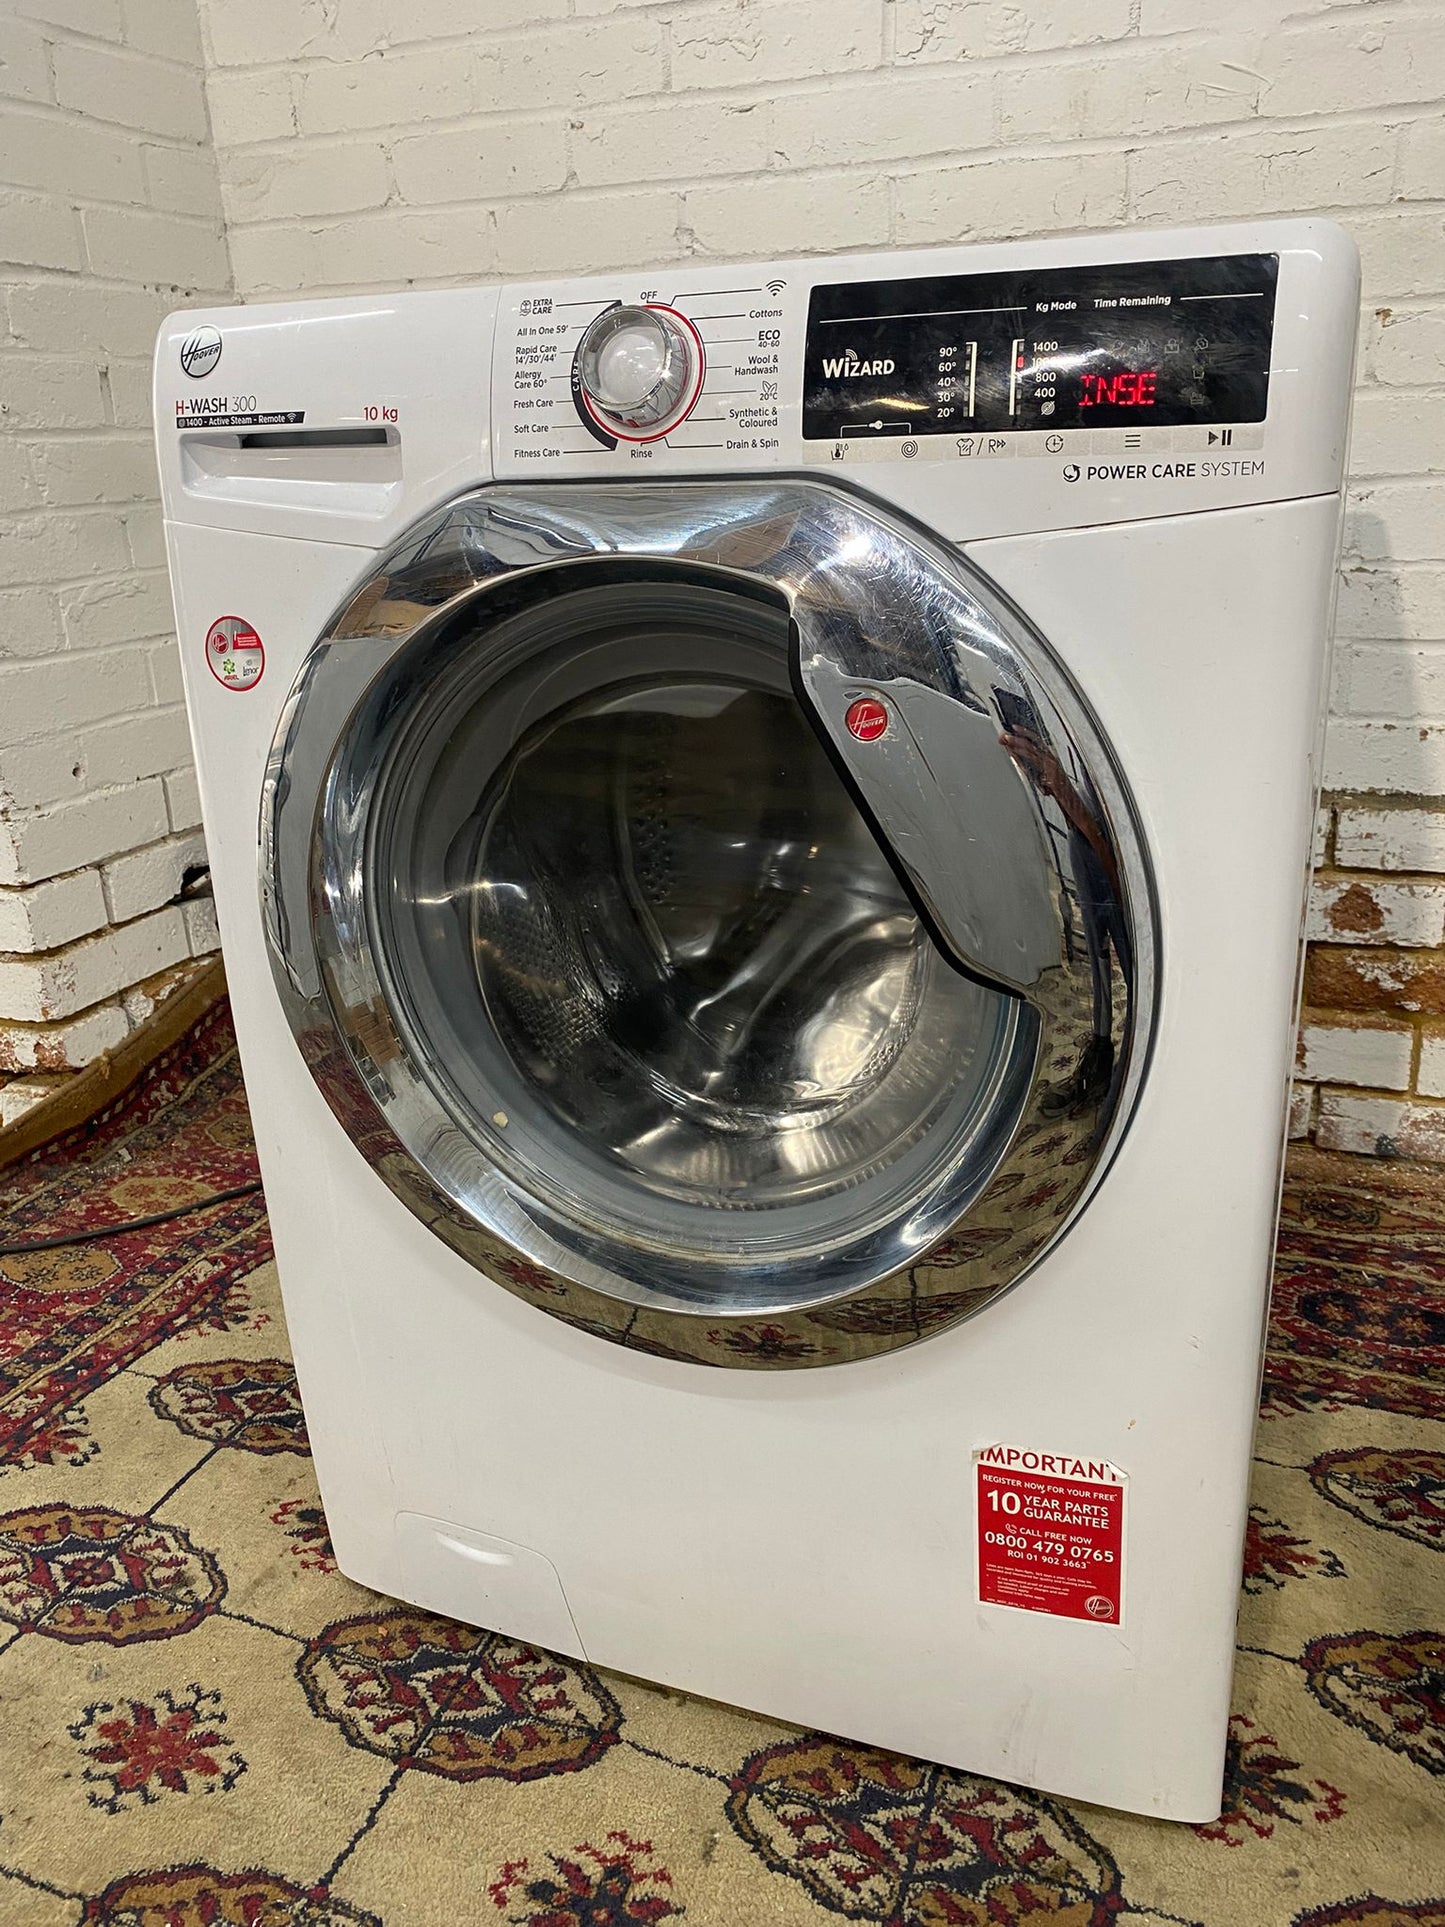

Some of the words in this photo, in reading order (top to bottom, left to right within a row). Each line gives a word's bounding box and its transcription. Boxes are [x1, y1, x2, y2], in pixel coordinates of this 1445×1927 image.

[640, 290, 658, 300] OFF
[1035, 303, 1049, 312] Kg
[1051, 301, 1077, 311] Mode
[1094, 299, 1117, 308] Time
[1120, 295, 1171, 306] Remaining
[532, 306, 553, 314] CARE
[750, 309, 783, 318] Cottons
[516, 328, 527, 336] All
[529, 328, 537, 336] In
[538, 326, 555, 335] One
[556, 324, 568, 333] 59'
[758, 329, 781, 341] ECO
[758, 340, 780, 348] 40-60
[1033, 341, 1058, 352] 1400
[516, 345, 538, 355] Rapid
[540, 345, 557, 353] Care
[939, 346, 957, 357] 90°
[748, 355, 771, 364] Wool
[772, 354, 779, 363] &
[735, 365, 779, 376] Handwash
[938, 362, 957, 372] 60°
[515, 371, 541, 380] Allergy
[1035, 372, 1056, 382] 800
[514, 381, 531, 389] Care
[937, 377, 956, 387] 40°
[760, 392, 778, 401] 20°C
[1034, 387, 1055, 397] 400
[176, 397, 228, 415] H-WASH
[232, 396, 257, 412] 300
[514, 400, 534, 408] Fresh
[536, 399, 554, 407] Care
[364, 406, 378, 421] 10
[383, 406, 398, 422] kg
[730, 408, 770, 419] Synthetic
[771, 407, 778, 416] &
[937, 407, 954, 417] 20°
[186, 418, 203, 427] 1400
[209, 417, 229, 426] Active
[231, 416, 252, 425] Steam
[259, 414, 285, 424] Remote
[739, 417, 778, 428] Coloured
[514, 424, 529, 433] Soft
[531, 424, 549, 432] Care
[726, 440, 749, 449] Drain
[751, 439, 757, 448] &
[760, 438, 779, 449] Spin
[514, 449, 541, 458] Fitness
[543, 448, 560, 457] Care
[631, 449, 653, 458] Rinse
[1087, 465, 1147, 480] POWER
[1152, 463, 1196, 478] CARE
[1201, 461, 1265, 477] SYSTEM
[983, 1474, 1022, 1488] REGISTER
[1047, 1486, 1064, 1495] FOR
[1067, 1488, 1091, 1499] YOUR
[987, 1490, 1020, 1515] 10
[1023, 1495, 1060, 1510] YEAR
[1065, 1501, 1109, 1517] PARTS
[1023, 1507, 1110, 1530] GUARANTEE
[1020, 1528, 1042, 1538] CALL
[1045, 1531, 1067, 1541] FREE
[1070, 1536, 1092, 1545] NOW
[985, 1531, 1027, 1549] 0800
[1033, 1541, 1065, 1555] 479
[1071, 1546, 1114, 1563] 0765
[1008, 1549, 1024, 1559] ROI
[1026, 1553, 1038, 1561] 01
[1041, 1556, 1060, 1566] 902
